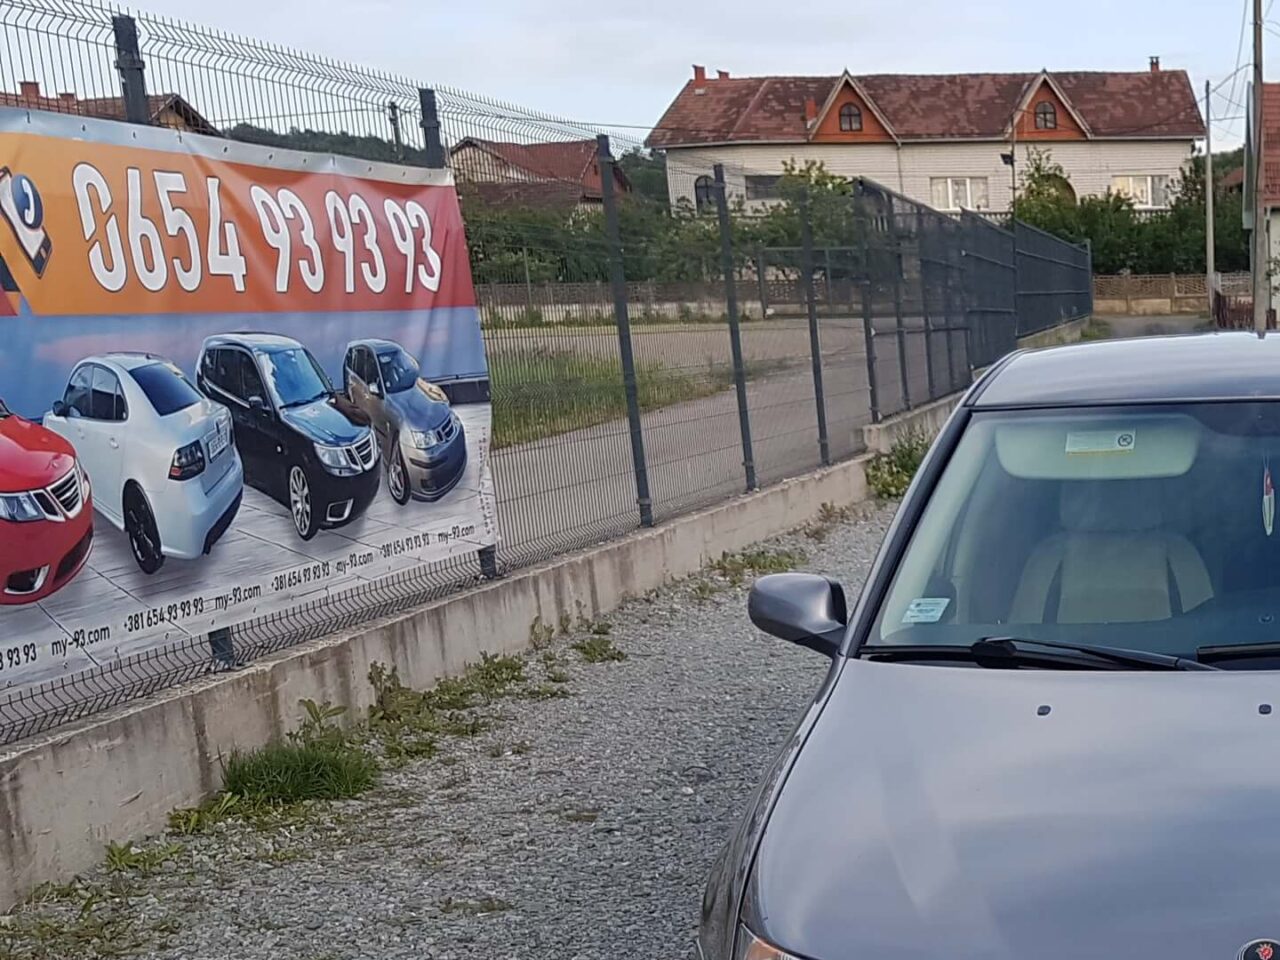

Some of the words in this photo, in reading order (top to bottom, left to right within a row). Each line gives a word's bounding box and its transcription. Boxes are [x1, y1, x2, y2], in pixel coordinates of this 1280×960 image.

[72, 162, 246, 293] 0654
[250, 185, 324, 292] 93
[325, 190, 386, 293] 93
[384, 198, 441, 293] 93
[7, 647, 21, 668] 93
[23, 642, 37, 663] 93
[51, 626, 110, 656] my-93.com
[123, 614, 145, 632] +381
[146, 607, 165, 628] 654
[166, 604, 178, 621] 93
[180, 600, 191, 618] 93
[193, 597, 204, 615] 93
[215, 584, 261, 611] my-93.com
[287, 571, 301, 587] 654
[303, 567, 311, 583] 93
[313, 564, 321, 580] 93
[322, 561, 330, 577] 93
[335, 551, 373, 575] my-93.com
[406, 536, 414, 551] 93
[414, 534, 422, 549] 93
[422, 532, 430, 547] 93
[437, 524, 475, 545] my-93.com
